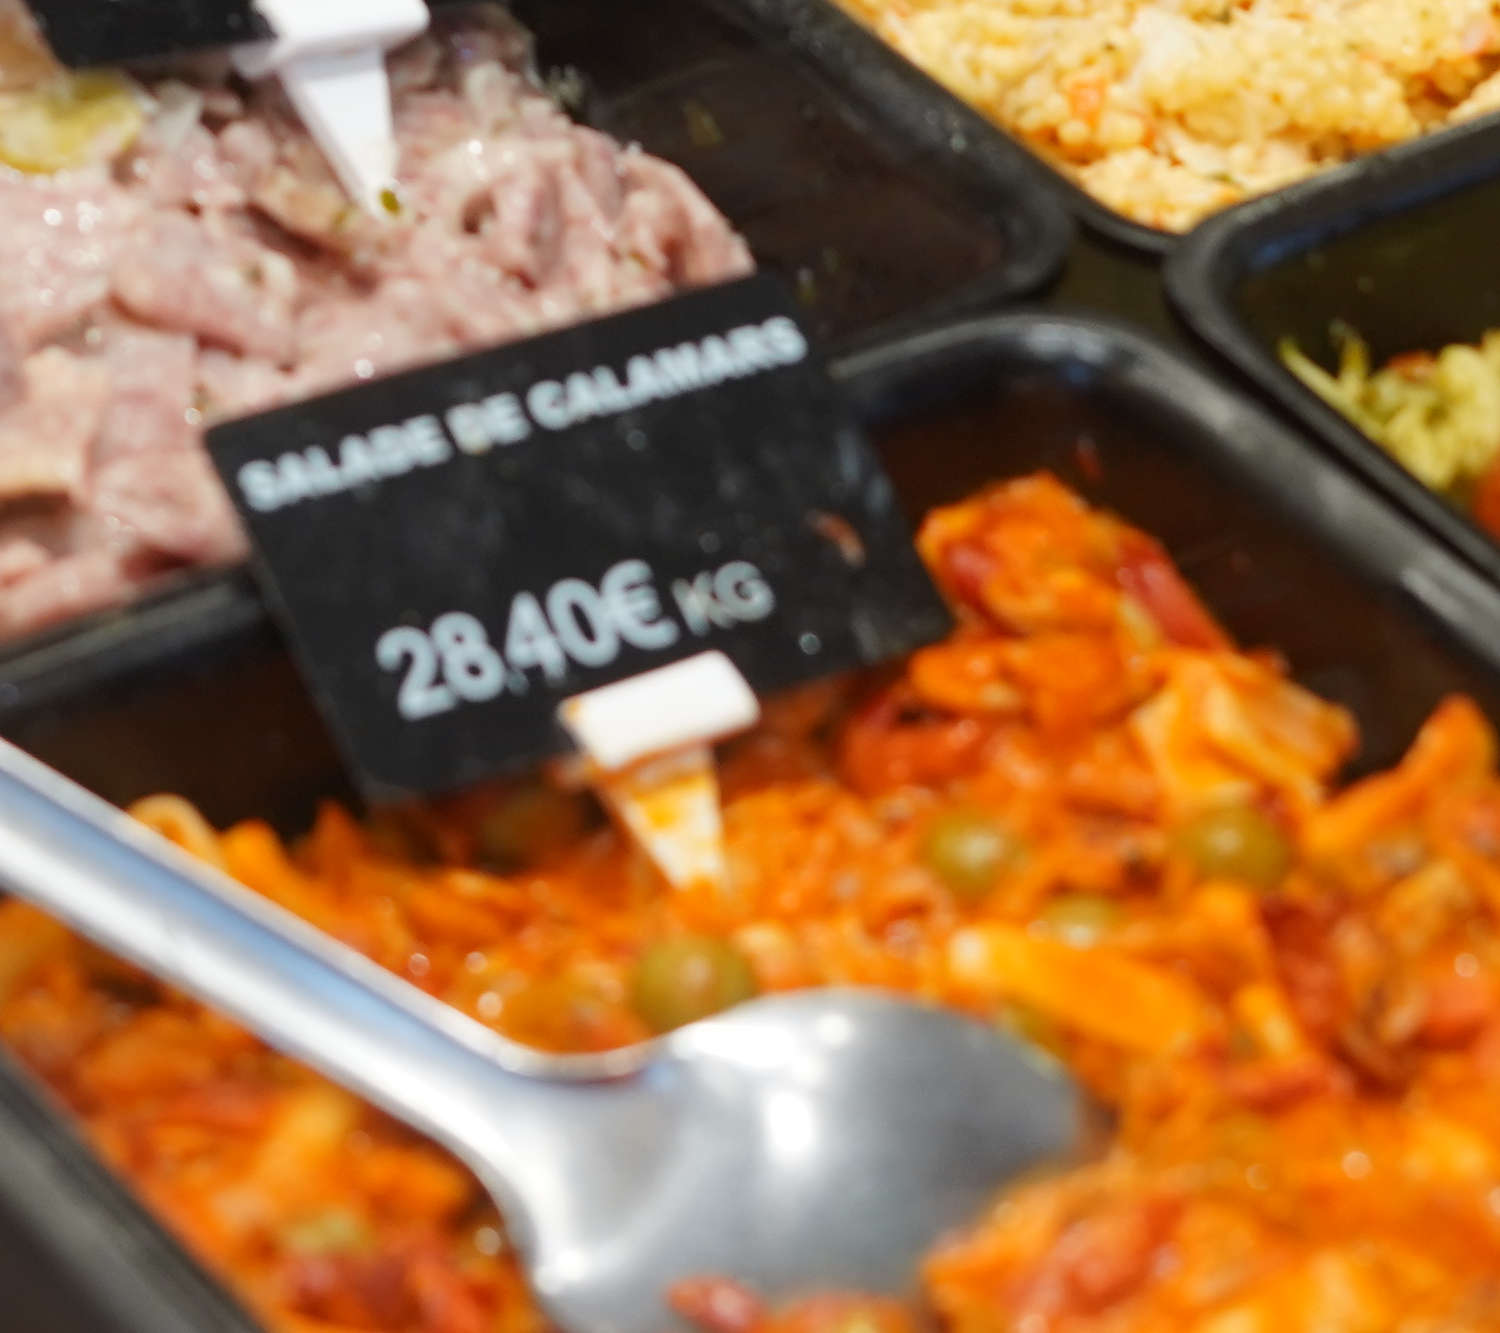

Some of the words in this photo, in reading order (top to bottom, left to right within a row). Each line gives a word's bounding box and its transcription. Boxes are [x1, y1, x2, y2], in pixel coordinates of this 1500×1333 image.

[237, 413, 454, 513] SALADE
[445, 390, 533, 456] DE
[526, 314, 808, 432] CALAMARS
[376, 558, 680, 722] 28,40€
[671, 559, 778, 637] KG
